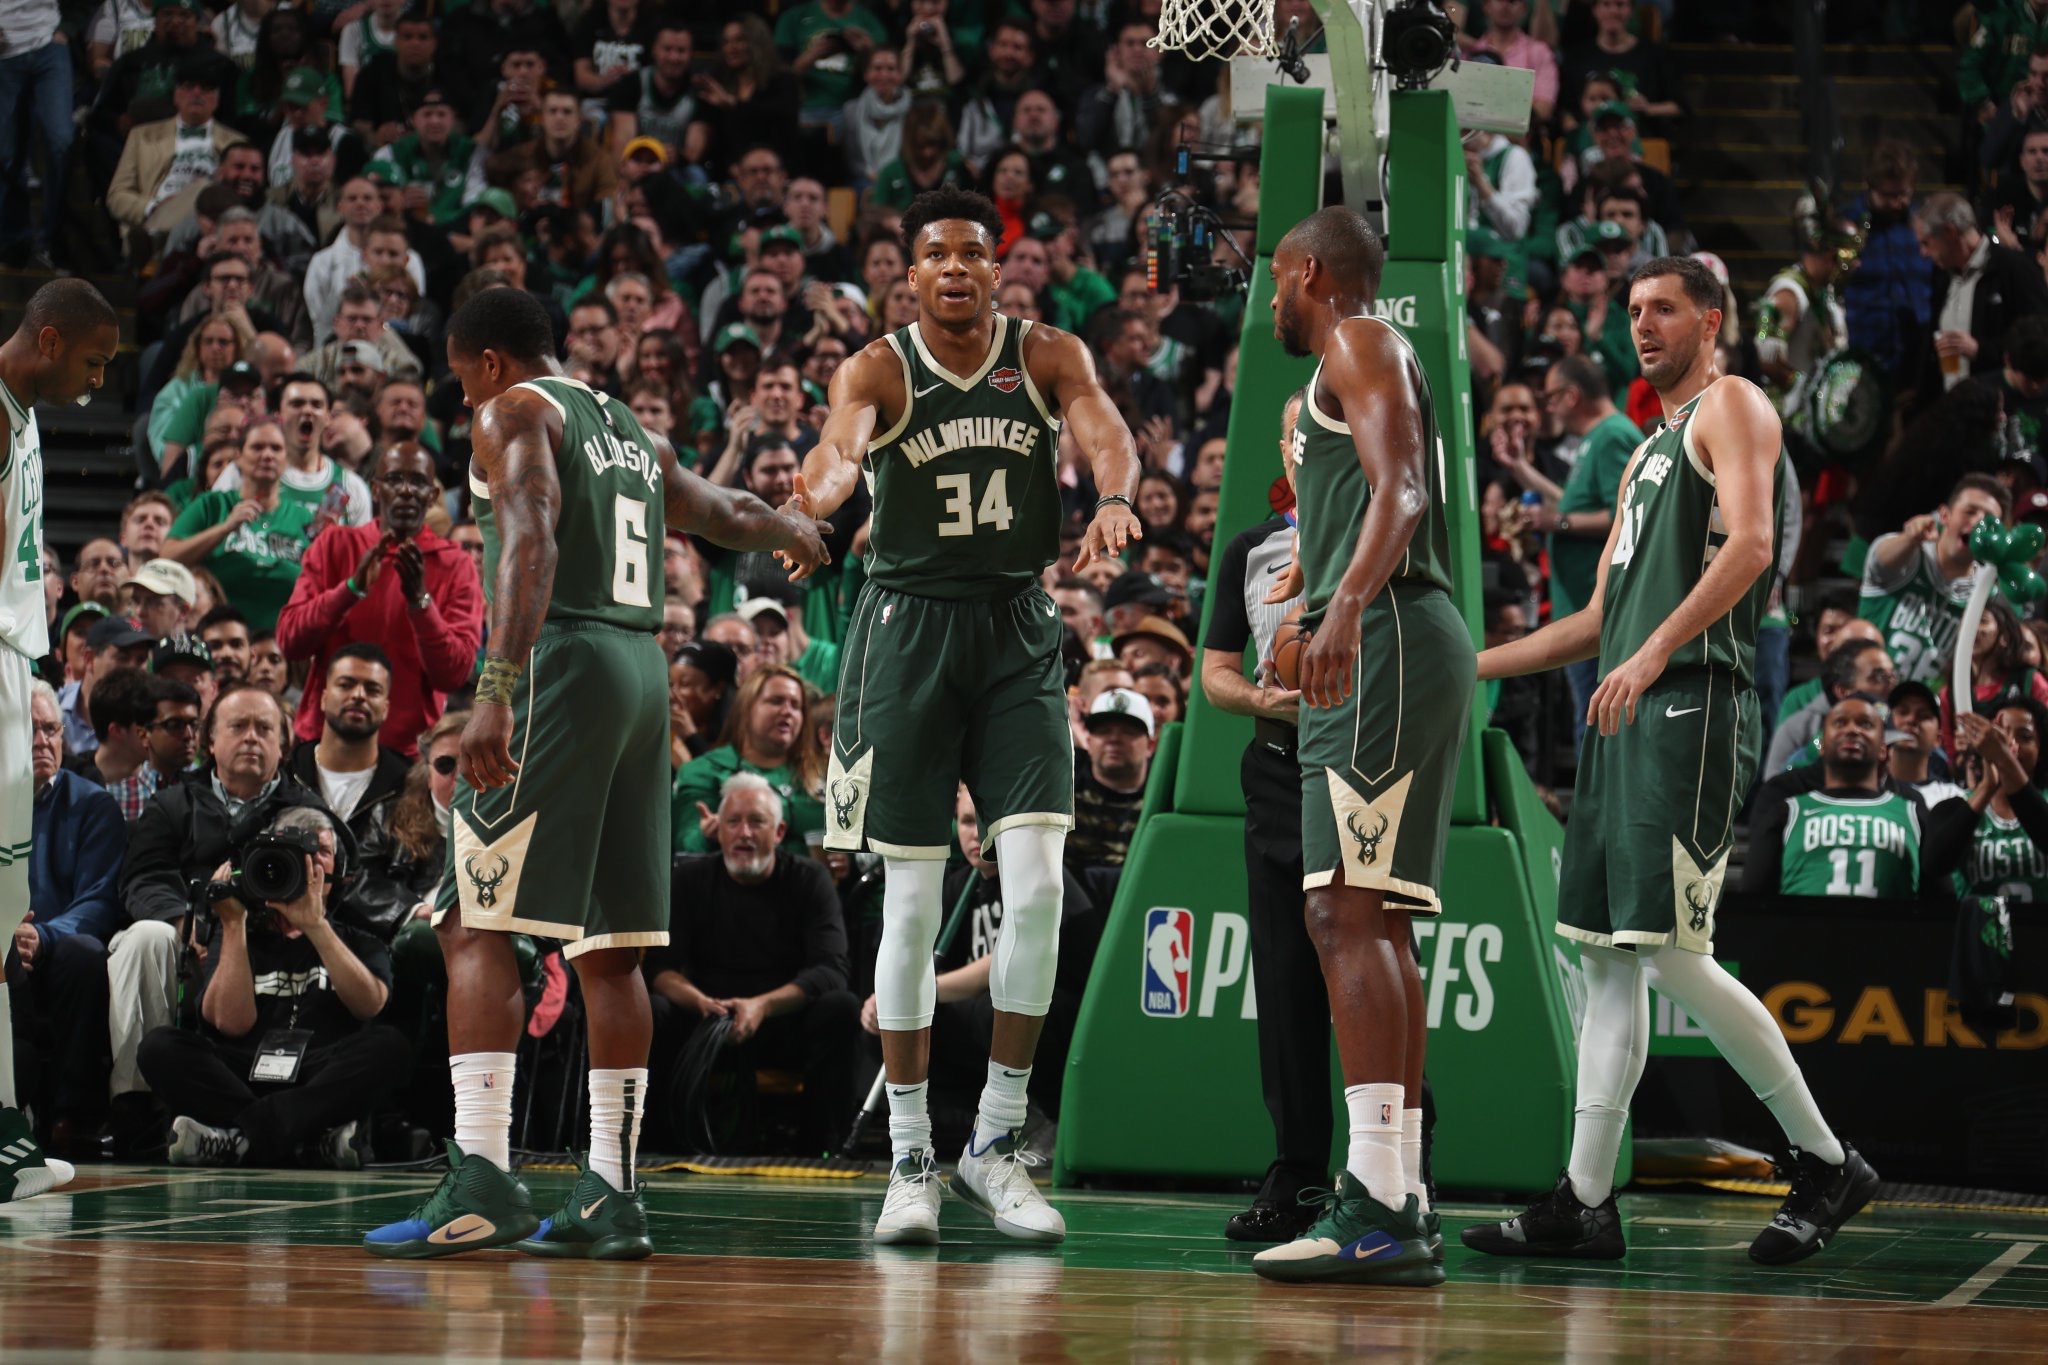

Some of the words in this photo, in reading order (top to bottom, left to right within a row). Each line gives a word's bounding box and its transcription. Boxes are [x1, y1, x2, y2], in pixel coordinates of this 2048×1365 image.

[899, 416, 1040, 469] MILWAUKEE
[936, 468, 1014, 537] 34
[17, 511, 44, 583] 4
[612, 493, 652, 608] 6
[1803, 814, 1906, 858] BOSTON
[1967, 837, 2048, 886] BOSTO
[1826, 848, 1879, 898] 11
[1148, 991, 1171, 1010] NBA
